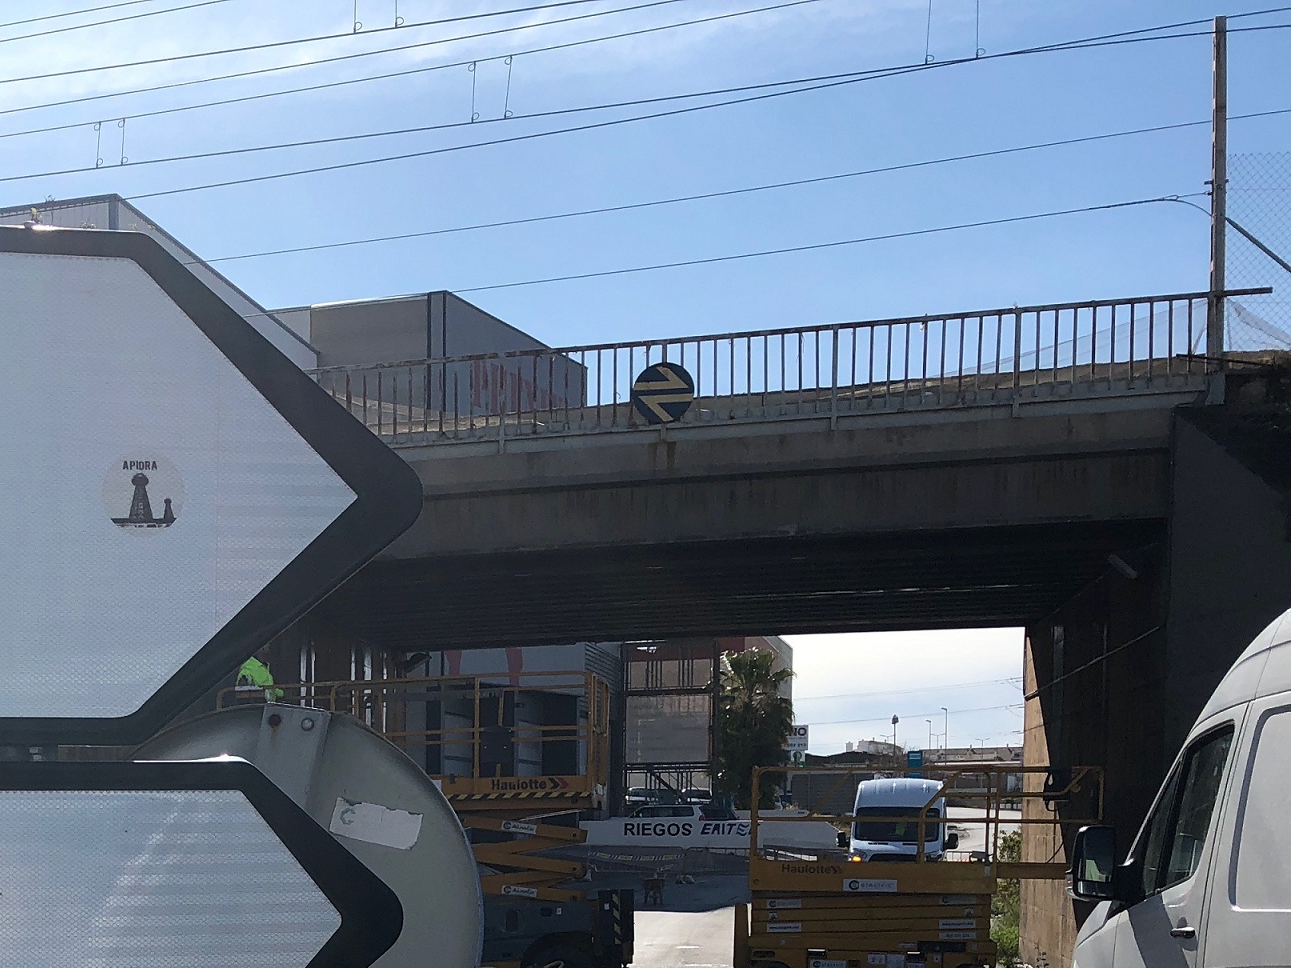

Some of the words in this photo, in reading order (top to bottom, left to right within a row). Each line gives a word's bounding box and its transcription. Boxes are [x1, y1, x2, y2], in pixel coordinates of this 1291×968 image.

[491, 778, 547, 791] Haulotte
[623, 822, 693, 837] RIEGOS
[781, 863, 833, 874] Haulotte
